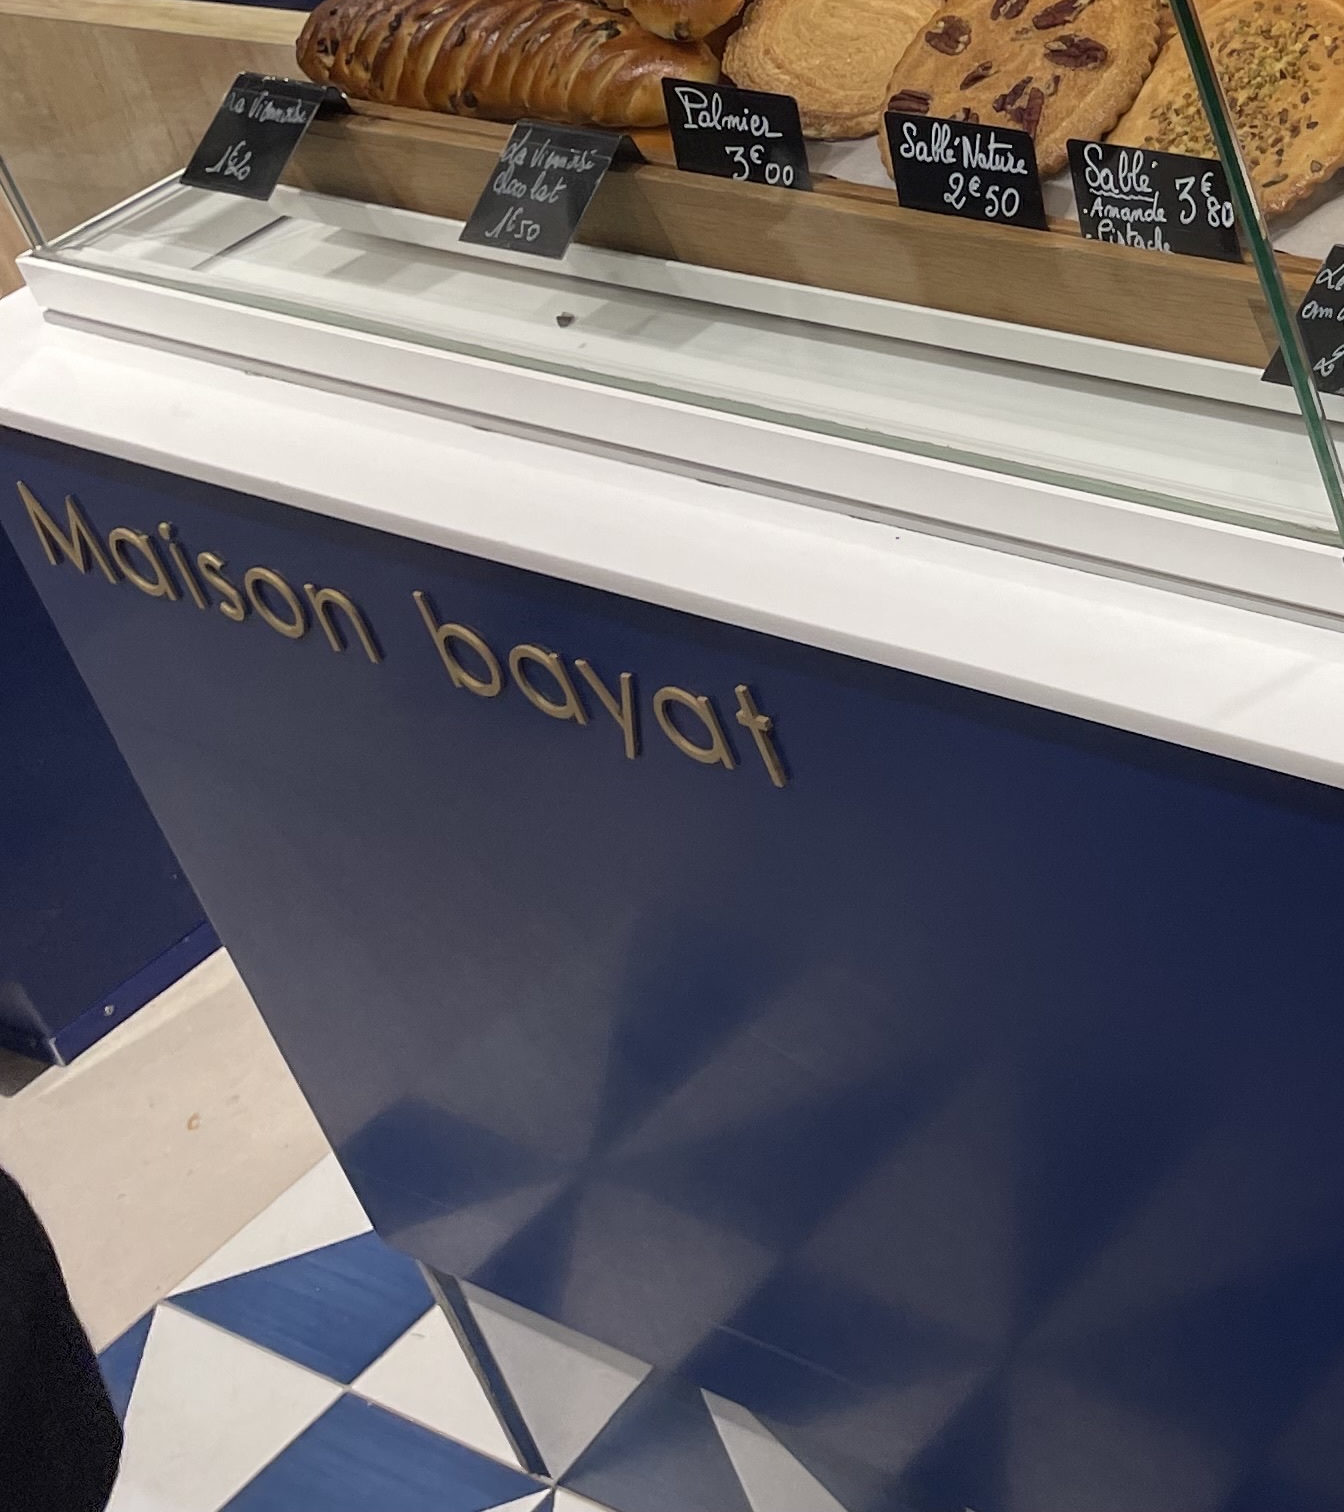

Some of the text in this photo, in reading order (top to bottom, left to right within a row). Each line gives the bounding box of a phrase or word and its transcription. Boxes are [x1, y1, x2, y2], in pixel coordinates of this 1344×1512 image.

[674, 86, 785, 139] Palmier
[724, 143, 795, 187] 3€00
[899, 120, 1029, 176] Sablé Nature
[1082, 142, 1160, 195] Sablé
[491, 162, 568, 204] chocolat
[943, 171, 1021, 219] 2€50
[1089, 190, 1168, 224] Amande
[15, 478, 788, 789] Maison bayat
